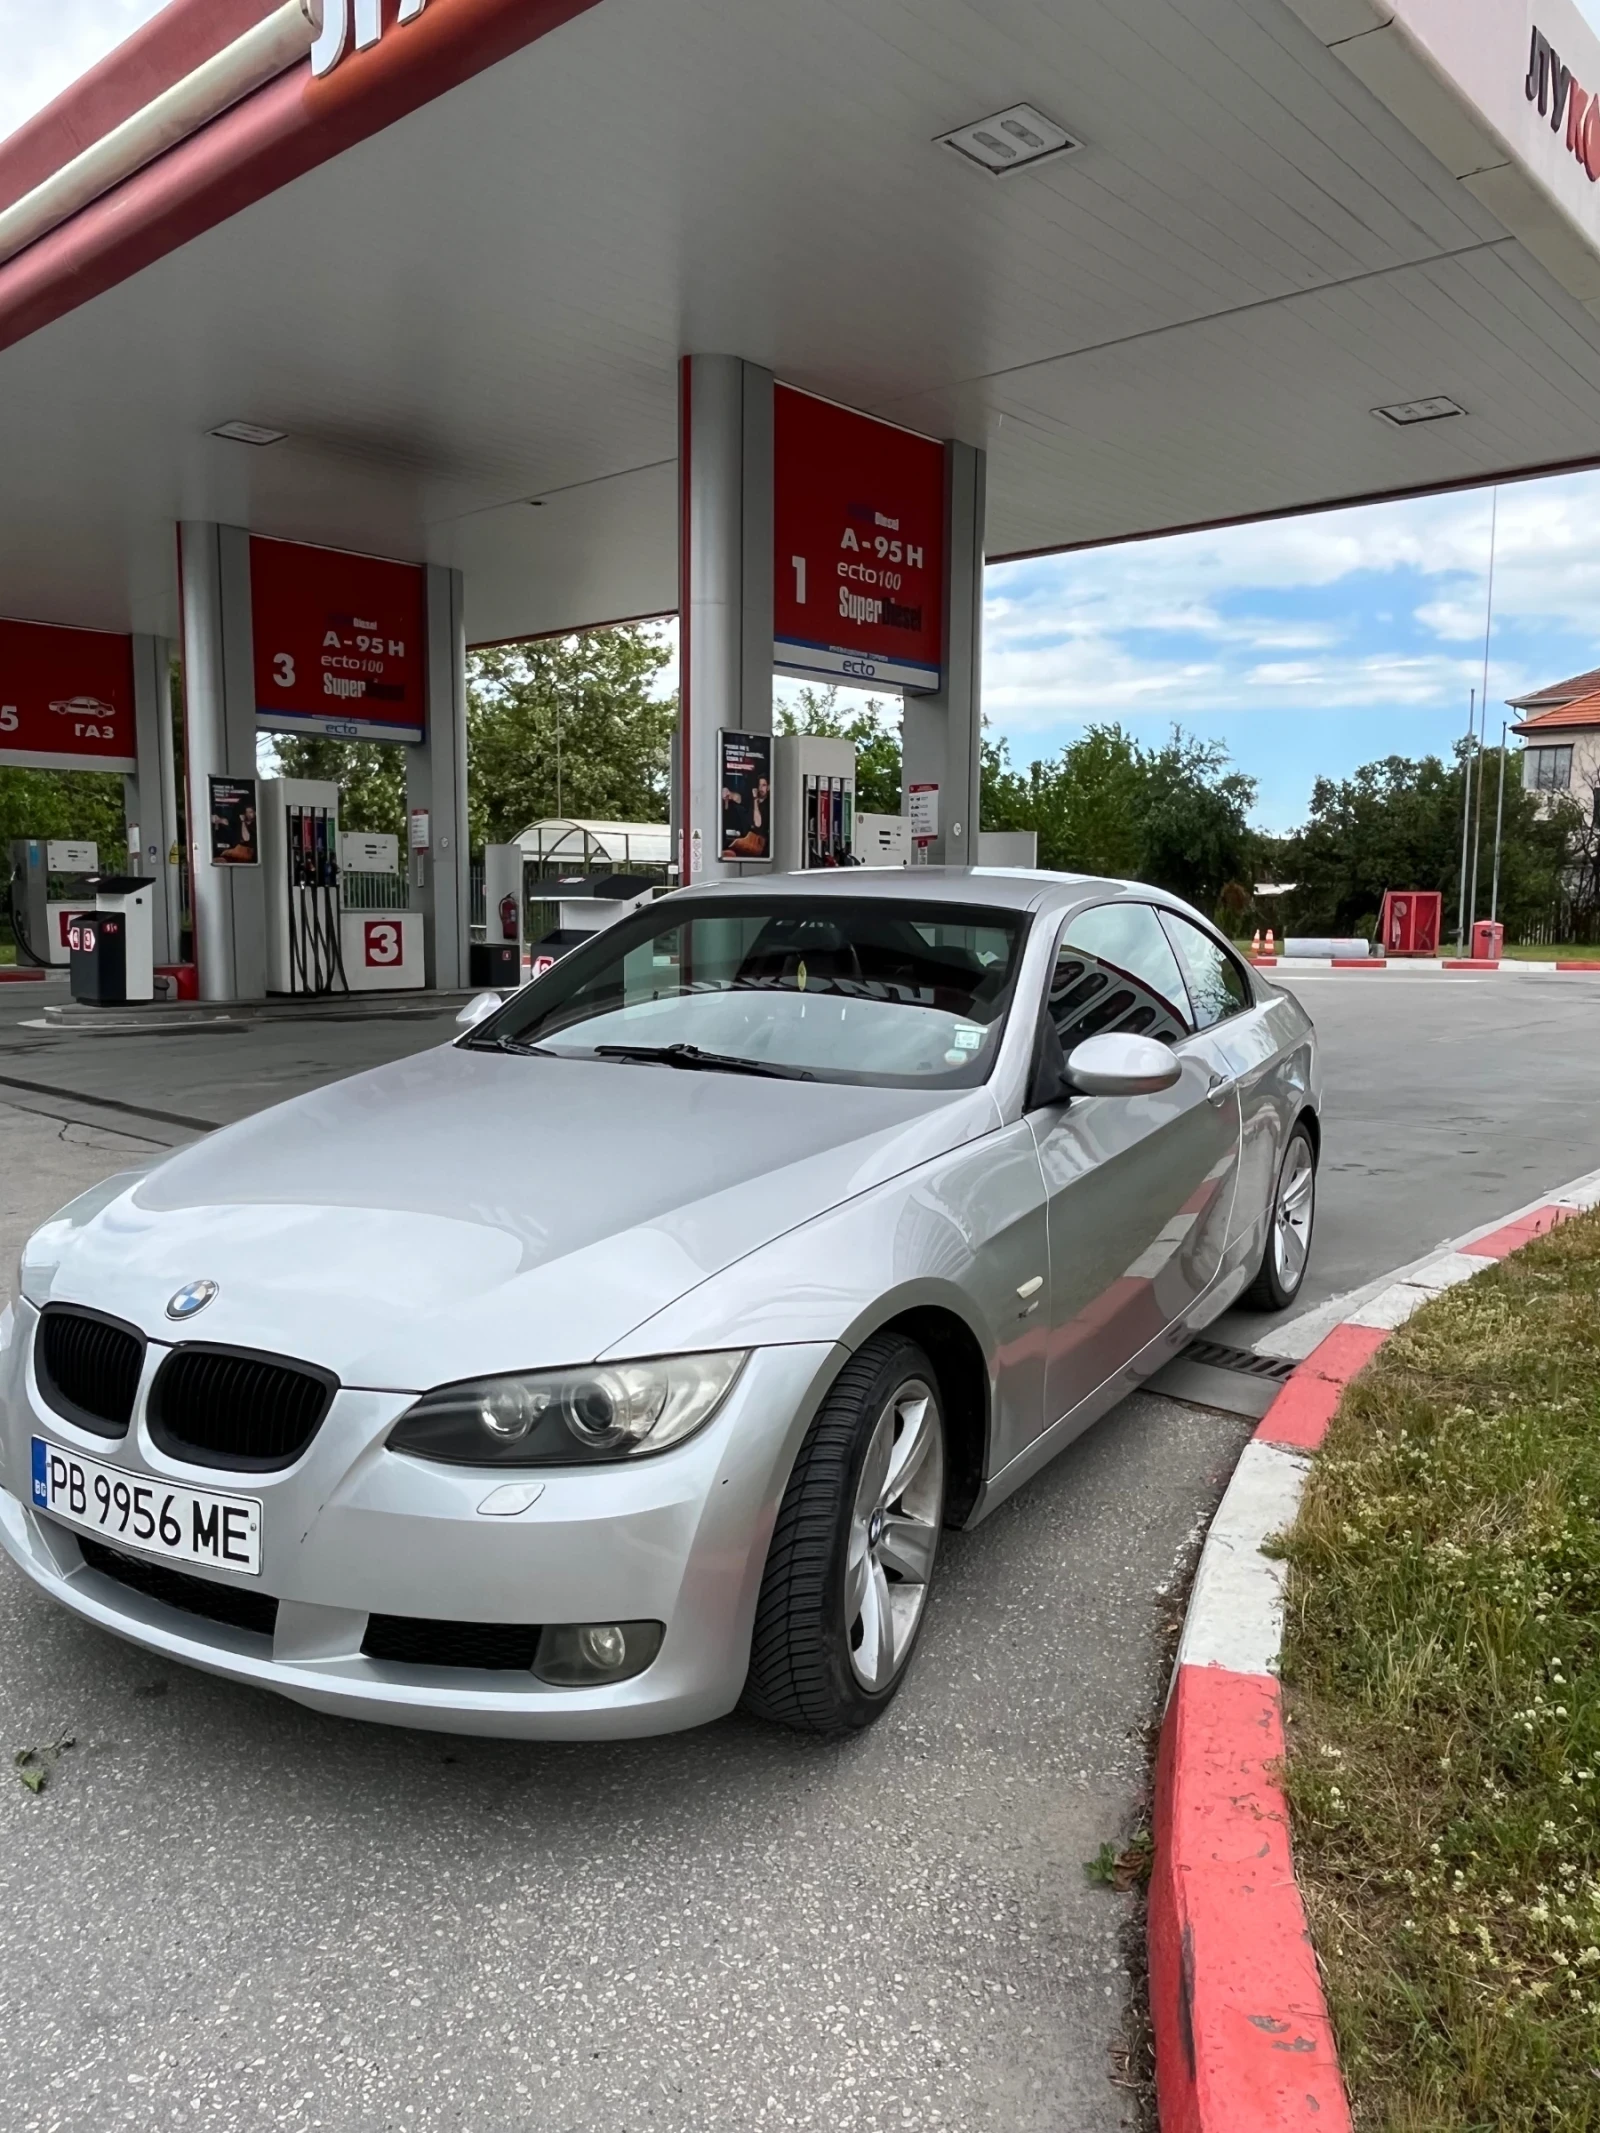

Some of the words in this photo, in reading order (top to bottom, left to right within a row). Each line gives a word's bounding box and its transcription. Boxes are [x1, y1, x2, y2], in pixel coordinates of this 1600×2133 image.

[791, 556, 806, 604] 1
[272, 652, 296, 688] 3
[842, 659, 876, 677] ecto
[0, 705, 19, 731] 5
[74, 723, 114, 739] ГАЗ
[325, 723, 358, 735] ecto
[368, 925, 401, 965] 3
[34, 1479, 47, 1497] BG
[50, 1455, 86, 1515] PB
[94, 1474, 182, 1547] 9956
[192, 1500, 251, 1564] ME
